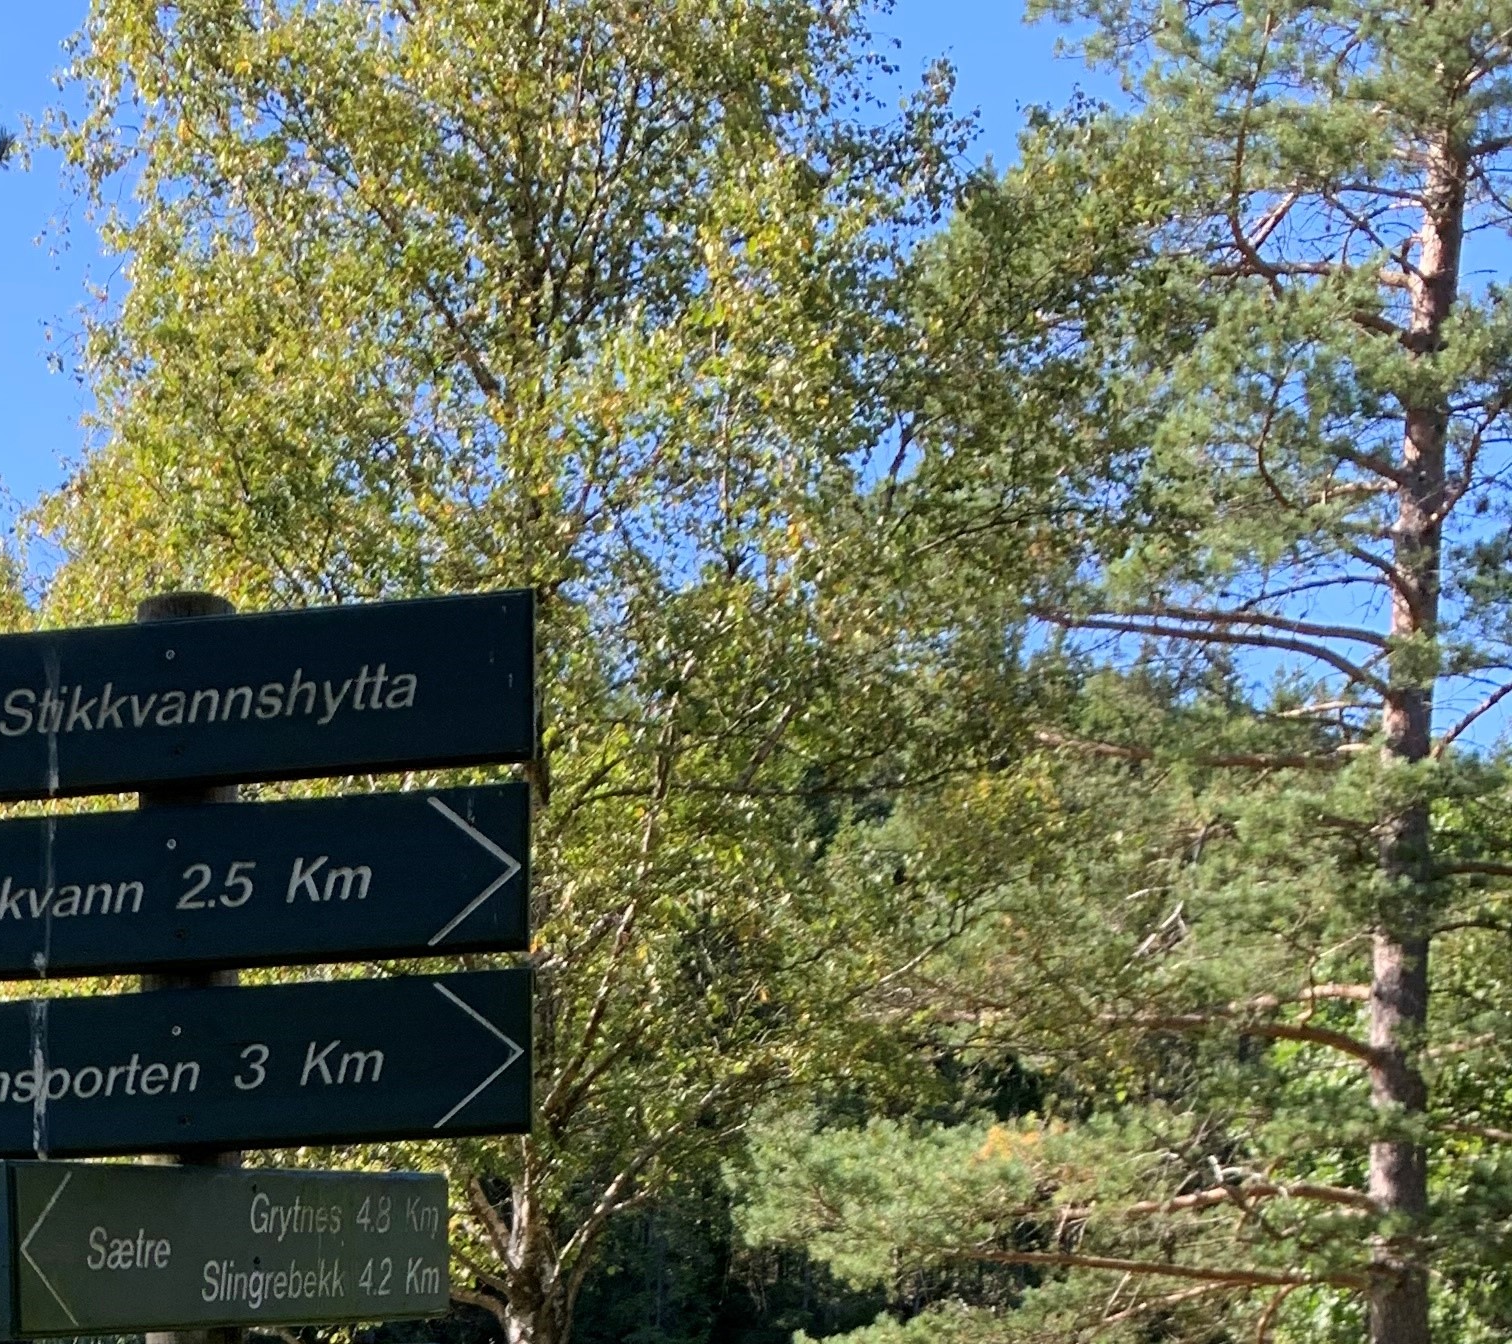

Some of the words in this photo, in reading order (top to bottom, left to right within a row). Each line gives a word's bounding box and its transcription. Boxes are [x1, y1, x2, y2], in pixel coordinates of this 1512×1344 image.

[0, 663, 417, 736] Stikkvannshytta
[176, 861, 256, 911] 2.5
[286, 856, 372, 903] Km
[235, 1044, 269, 1089] 3
[300, 1040, 384, 1086] Km
[250, 1193, 343, 1242] Grytnes
[406, 1196, 439, 1238] Km
[87, 1226, 172, 1270] Sætre
[202, 1259, 344, 1309] Slingrebekk
[358, 1258, 392, 1295] 4.2
[406, 1257, 440, 1294] Km
